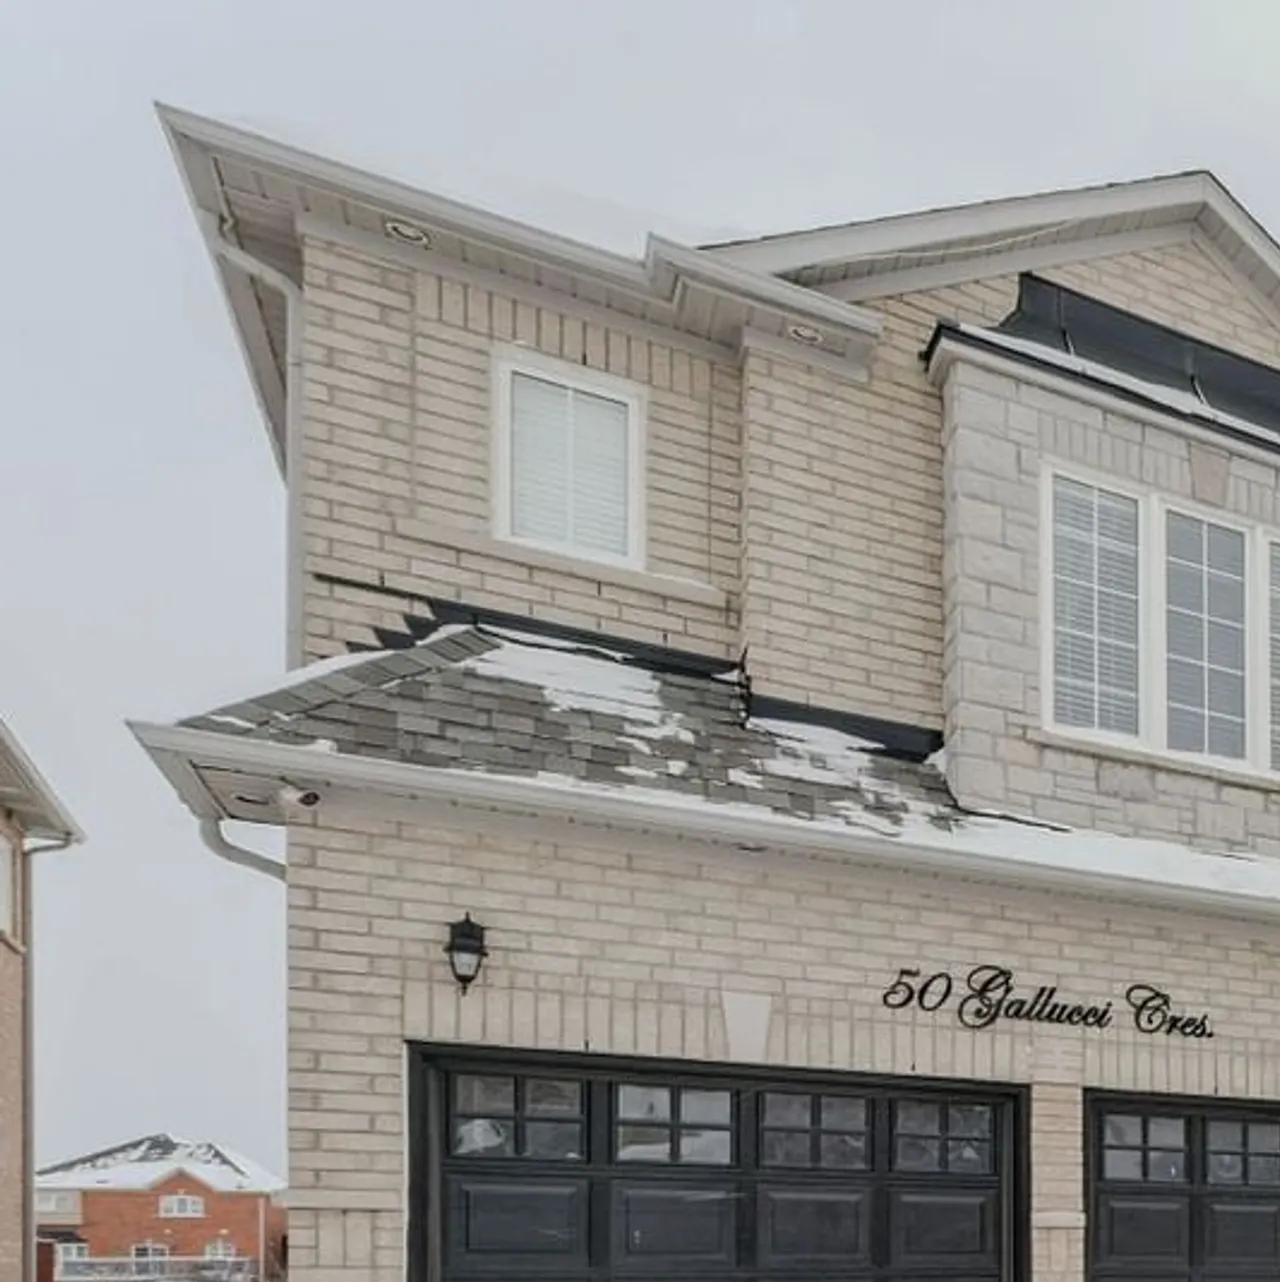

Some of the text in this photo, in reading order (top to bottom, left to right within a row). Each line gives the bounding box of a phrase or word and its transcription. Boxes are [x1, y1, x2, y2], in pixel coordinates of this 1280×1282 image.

[882, 965, 1215, 1038] 50 Gallucci Cres.
